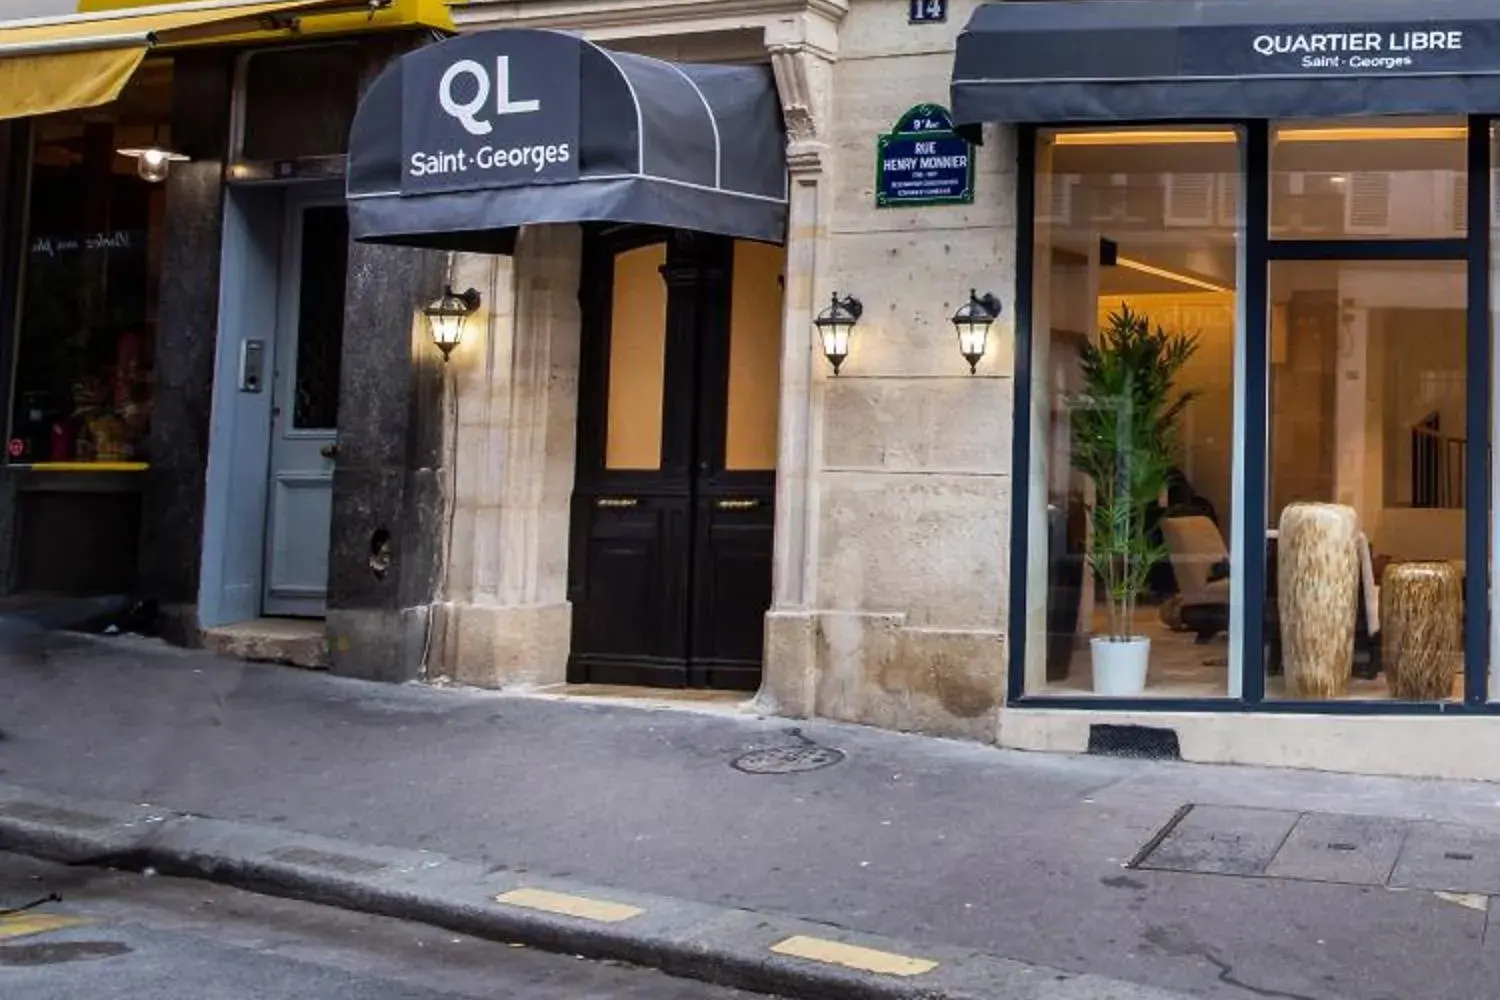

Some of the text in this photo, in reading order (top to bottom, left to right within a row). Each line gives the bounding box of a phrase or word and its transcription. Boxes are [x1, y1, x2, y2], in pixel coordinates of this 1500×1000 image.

[1252, 31, 1463, 55] QUARTIER LIBRE
[438, 55, 540, 136] QL
[914, 141, 937, 155] RUE
[883, 155, 967, 171] HENRY MONNIER
